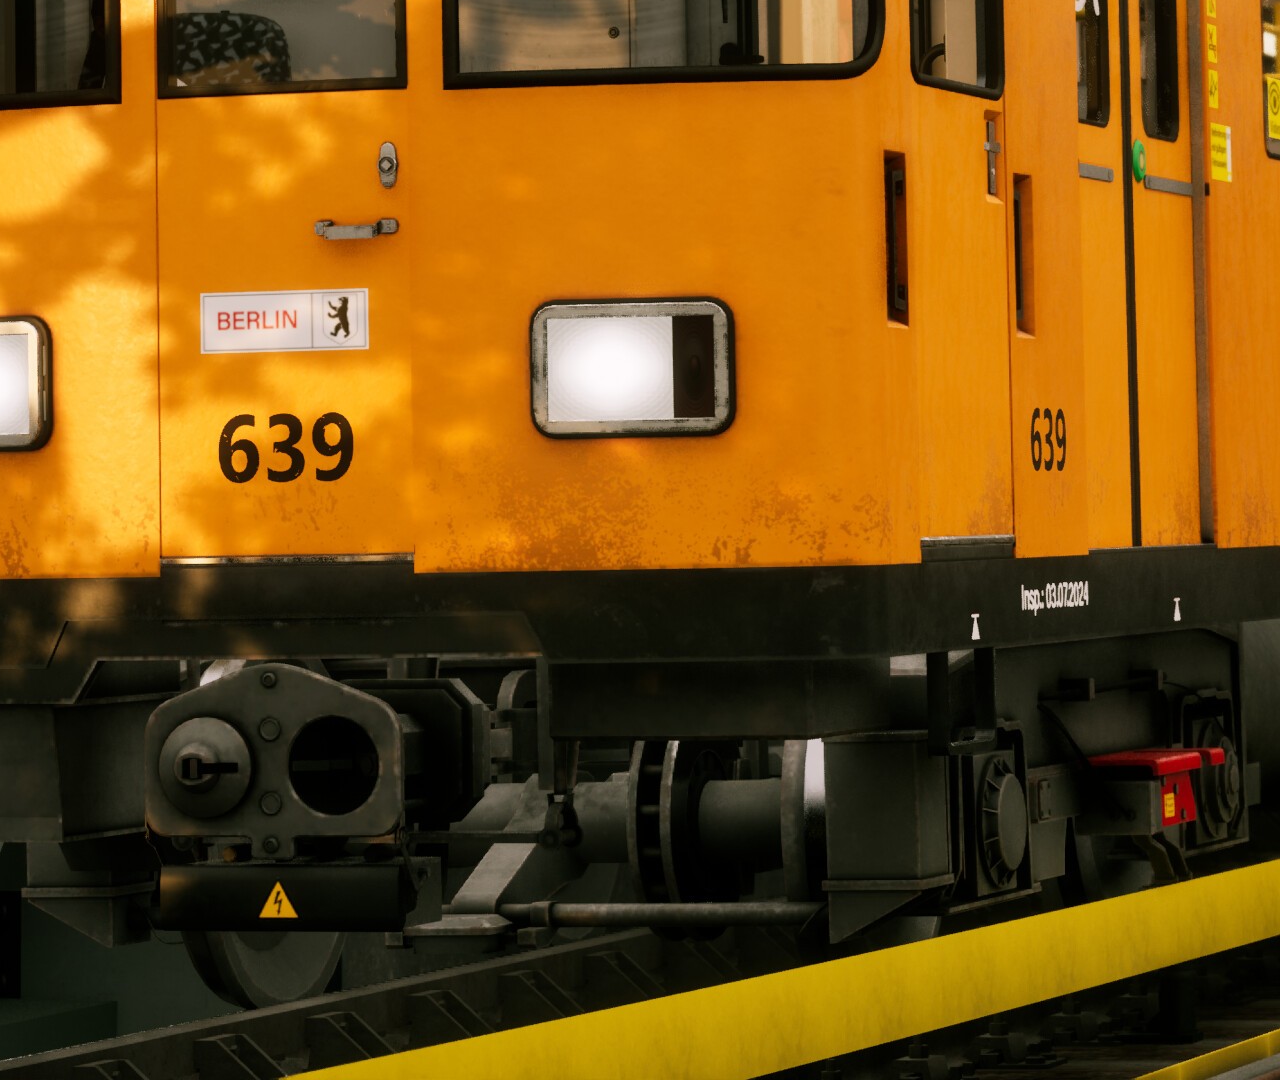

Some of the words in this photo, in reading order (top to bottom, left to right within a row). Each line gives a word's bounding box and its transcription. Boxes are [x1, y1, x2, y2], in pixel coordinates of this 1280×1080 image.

[217, 310, 298, 331] BERLIN
[218, 412, 354, 484] 639
[1030, 407, 1067, 472] 639
[1046, 581, 1089, 609] 03.07.2024
